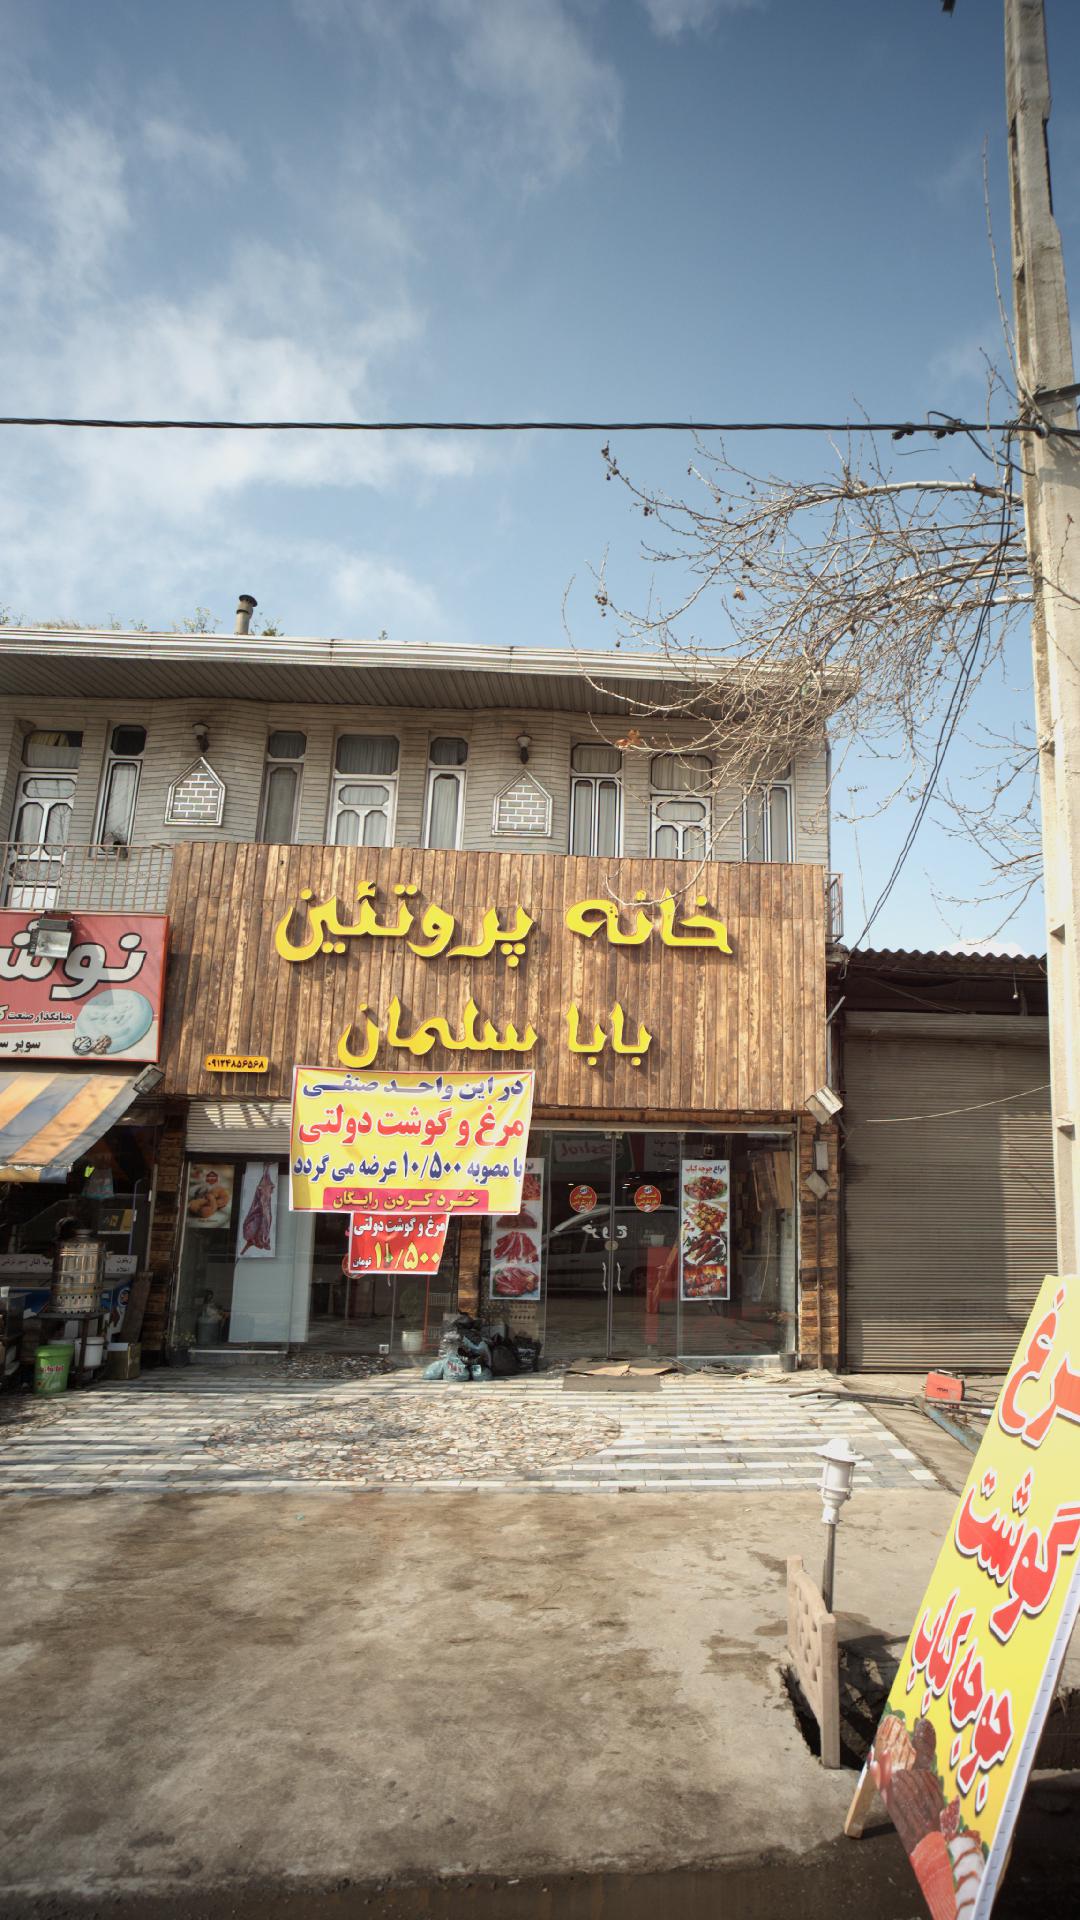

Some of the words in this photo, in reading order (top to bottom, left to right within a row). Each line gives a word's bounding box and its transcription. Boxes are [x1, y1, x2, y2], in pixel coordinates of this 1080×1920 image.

[275, 880, 534, 968] پروتئین
[565, 887, 734, 954] خانه
[337, 995, 538, 1068] سلمان
[566, 1001, 653, 1066] بابا
[303, 1073, 378, 1097] صنفی
[383, 1076, 454, 1100] واحد
[459, 1076, 494, 1100] این
[498, 1078, 524, 1101] در
[298, 1103, 372, 1144] دولتی
[376, 1106, 453, 1146] گوشت
[455, 1118, 470, 1147] و
[474, 1104, 524, 1147] مرغ
[293, 1155, 330, 1182] گردد
[331, 1163, 355, 1181] می
[358, 1155, 397, 1183] عرضه
[403, 1151, 462, 1180] ۱۰/۵۰۰
[467, 1160, 510, 1184] مصوبه
[513, 1156, 523, 1183] با
[332, 1190, 379, 1210] رایگان
[353, 1216, 384, 1237] دولتی
[385, 1217, 416, 1237] گوشت
[417, 1222, 424, 1237] و
[424, 1216, 446, 1237] مرغ
[352, 1257, 372, 1268] تومان
[955, 1469, 1080, 1637] گوشت
[907, 1588, 975, 1713] کباب
[950, 1640, 1014, 1812] جوجه
